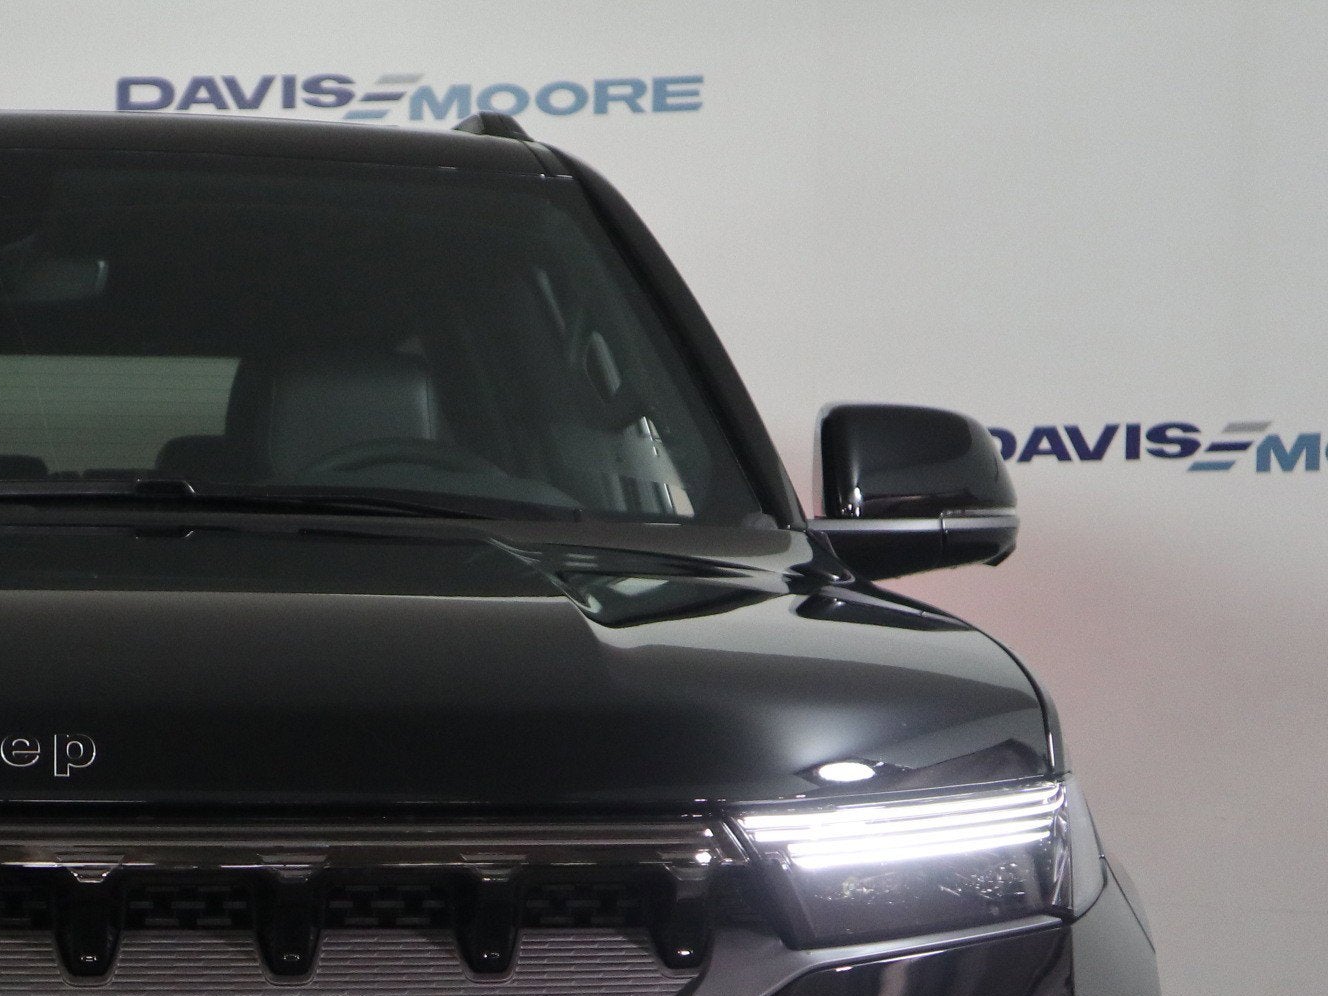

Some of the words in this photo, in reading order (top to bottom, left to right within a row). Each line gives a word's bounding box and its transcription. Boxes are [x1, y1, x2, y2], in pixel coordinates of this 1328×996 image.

[116, 73, 356, 111] DAVIS
[409, 75, 704, 121] MOORE
[1256, 432, 1328, 473] M
